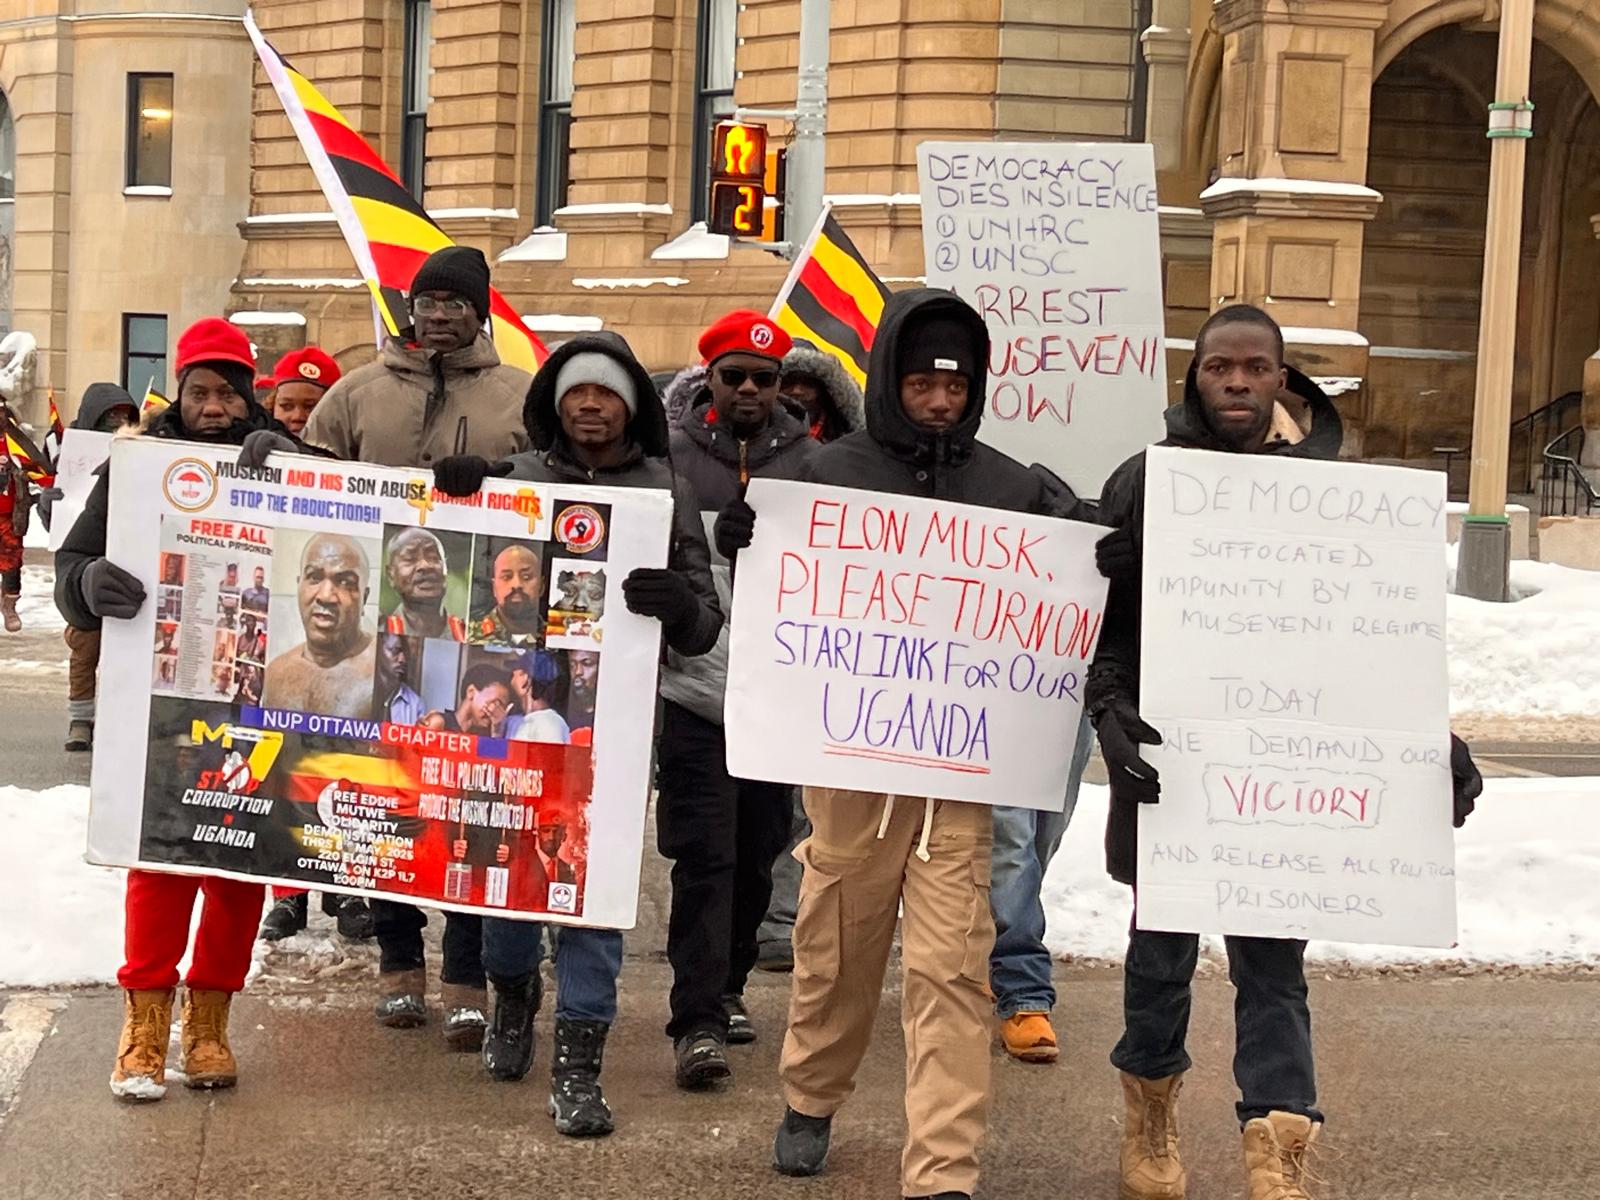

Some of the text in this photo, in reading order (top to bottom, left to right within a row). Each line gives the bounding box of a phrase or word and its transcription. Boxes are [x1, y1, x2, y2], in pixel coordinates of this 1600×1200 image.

[928, 153, 1123, 186] DEMOCRACY
[734, 185, 753, 230] 2
[937, 183, 1010, 208] DIES
[972, 243, 1075, 276] UNSC
[950, 284, 1128, 326] RREST
[987, 334, 1158, 380] USEVENI
[991, 382, 1075, 427] OW
[215, 460, 282, 485] MUSEVENI
[287, 469, 315, 488] AND
[319, 473, 343, 491] HIS
[347, 476, 376, 496] SON
[380, 480, 426, 501] ABUSE
[487, 492, 541, 514] RIGHTS
[1168, 467, 1445, 528] DEMOCRACY
[230, 488, 381, 524] STOP THE ABDUCTIONS!!
[176, 533, 226, 549] POLITICAL
[190, 519, 267, 545] FREE ALL
[808, 500, 910, 555] ELON
[1189, 538, 1374, 568] SUFFOCATED
[777, 552, 1101, 660] PLEASE TURN ON
[1159, 576, 1417, 604] IMPUNITY BY THE
[1352, 616, 1443, 641] REGIME
[774, 621, 938, 681] STARLINK
[1009, 653, 1079, 703] OUR
[1209, 676, 1322, 716] TODAY
[263, 710, 471, 753] NUP OTTAWA CHAPTER
[822, 682, 990, 760] UGANDA
[1246, 727, 1384, 763] DEMAND
[1400, 747, 1449, 770] OUR
[181, 788, 274, 816] CORRUPTION
[327, 790, 400, 809] REE EDDIE
[336, 804, 386, 820] MUTWE
[1223, 773, 1370, 822] VICTORY
[192, 824, 256, 849] UGANDA
[304, 824, 414, 849] DEMONSTRATION
[318, 849, 340, 861] 220
[342, 852, 378, 866] ELGIN
[387, 848, 414, 861] 2025
[1150, 843, 1199, 865] AND
[1211, 844, 1326, 875] RELEASE
[1342, 856, 1381, 875] ALL
[352, 865, 372, 878] ON
[373, 867, 396, 880] K2P
[1215, 879, 1383, 918] PRISONERS
